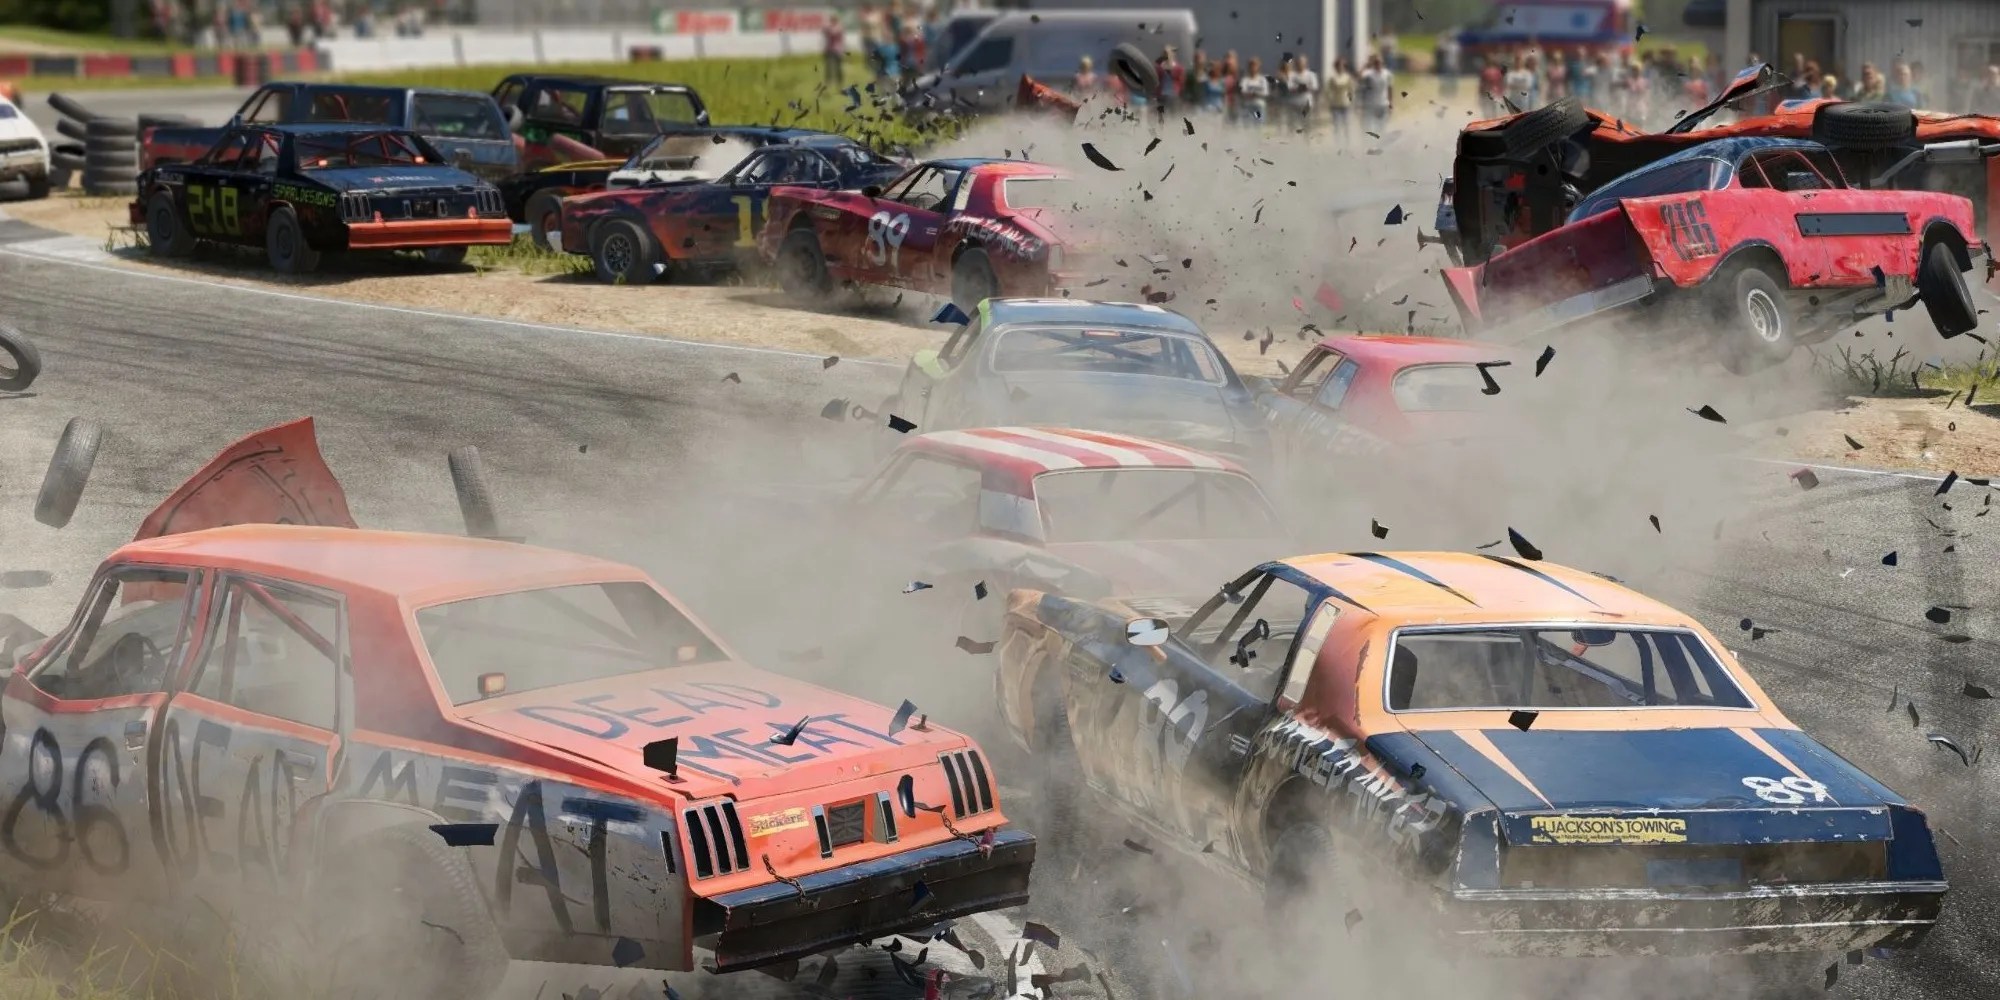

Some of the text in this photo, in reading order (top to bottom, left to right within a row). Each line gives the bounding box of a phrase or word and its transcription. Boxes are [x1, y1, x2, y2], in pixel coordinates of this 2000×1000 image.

[187, 185, 242, 235] 218
[730, 195, 770, 247] 1
[863, 211, 911, 272] 89
[516, 682, 781, 740] DEAD
[641, 713, 905, 786] MEAT
[3, 727, 130, 878] 86
[1742, 776, 1828, 804] 89
[162, 717, 648, 937] DEAD MEAT
[1627, 820, 1680, 833] TOWING
